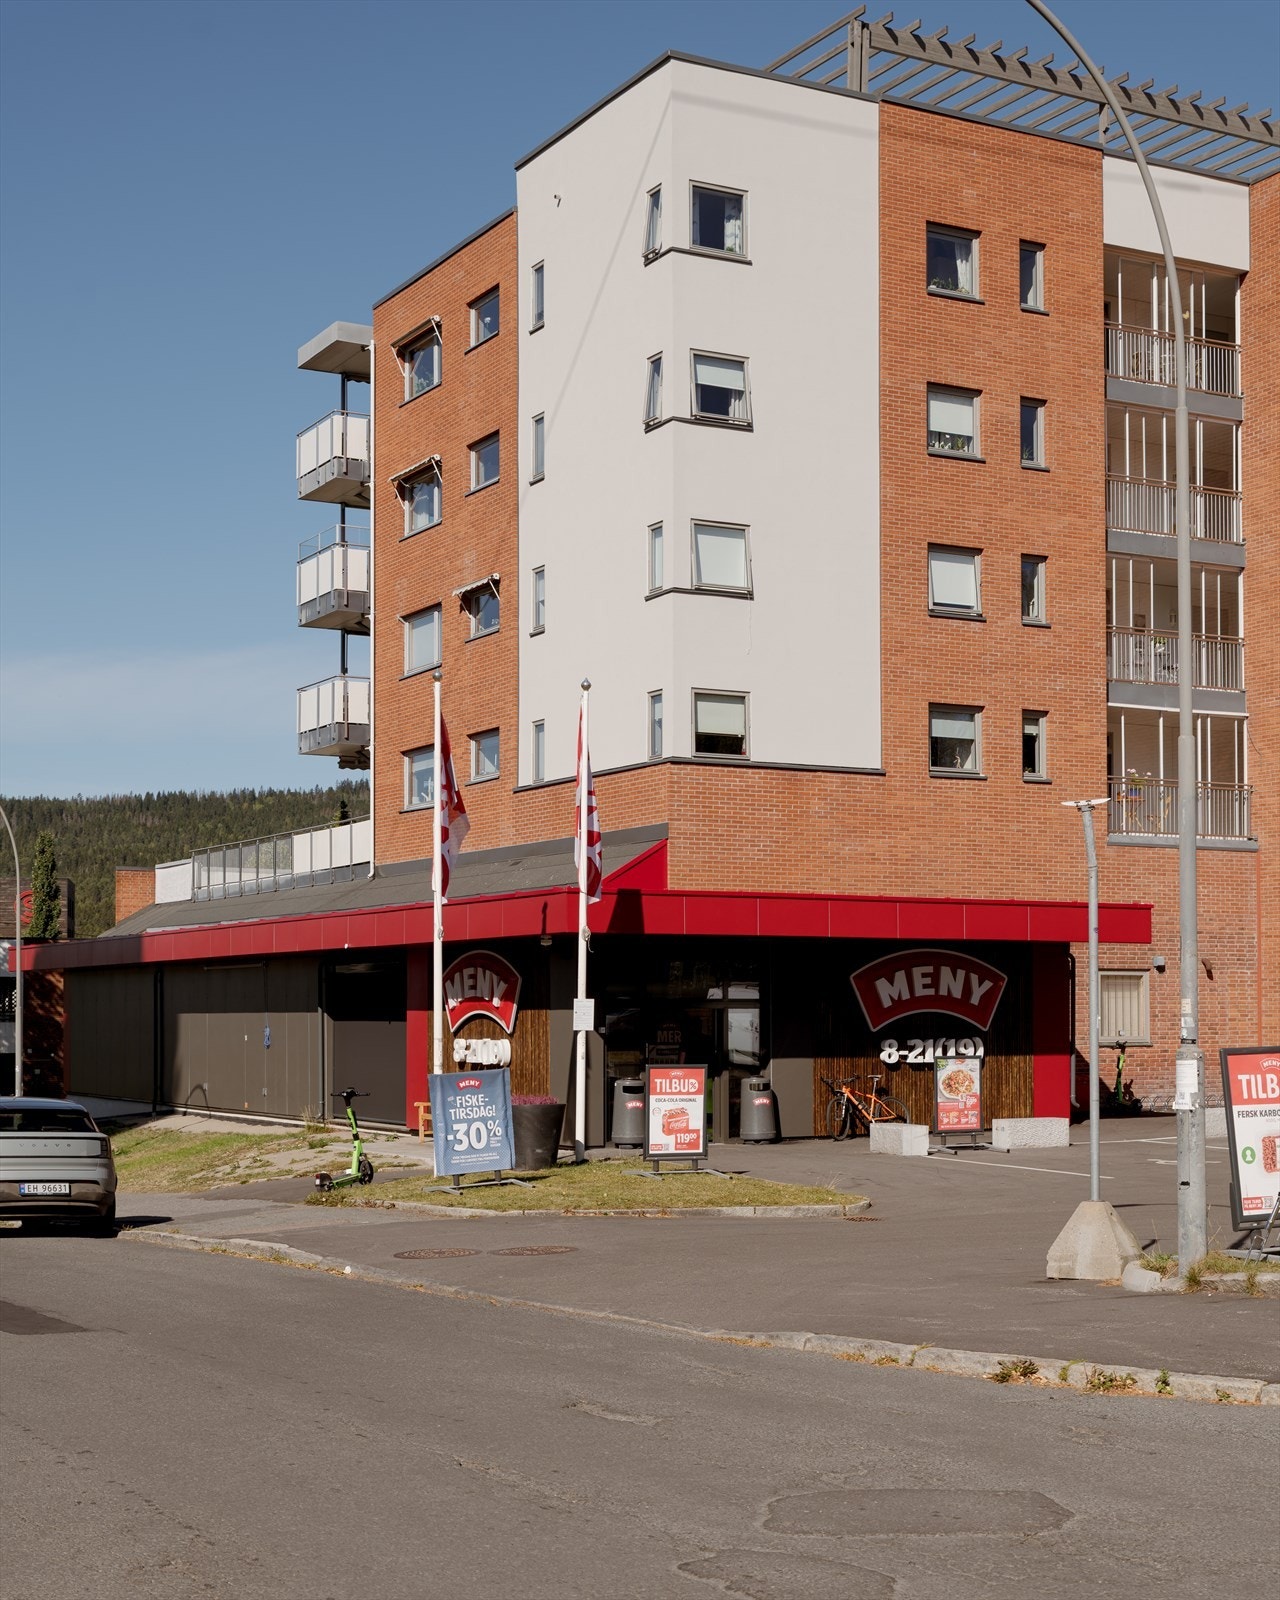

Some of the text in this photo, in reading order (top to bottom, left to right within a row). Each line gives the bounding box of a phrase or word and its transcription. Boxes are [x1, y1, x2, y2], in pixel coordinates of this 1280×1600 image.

[445, 967, 508, 1010] MENY
[875, 965, 994, 1009] MENY
[880, 1037, 984, 1064] 8-21(19)
[1263, 1060, 1280, 1068] MENY
[459, 1079, 480, 1088] MENY
[654, 1078, 699, 1093] TILBUD
[1237, 1073, 1280, 1100] TILB
[456, 1094, 489, 1108] FISKE-
[449, 1105, 496, 1120] TIRSDAG!
[1237, 1110, 1258, 1118] FERSK
[447, 1120, 502, 1151] -30%
[27, 1184, 67, 1193] EH 96631
